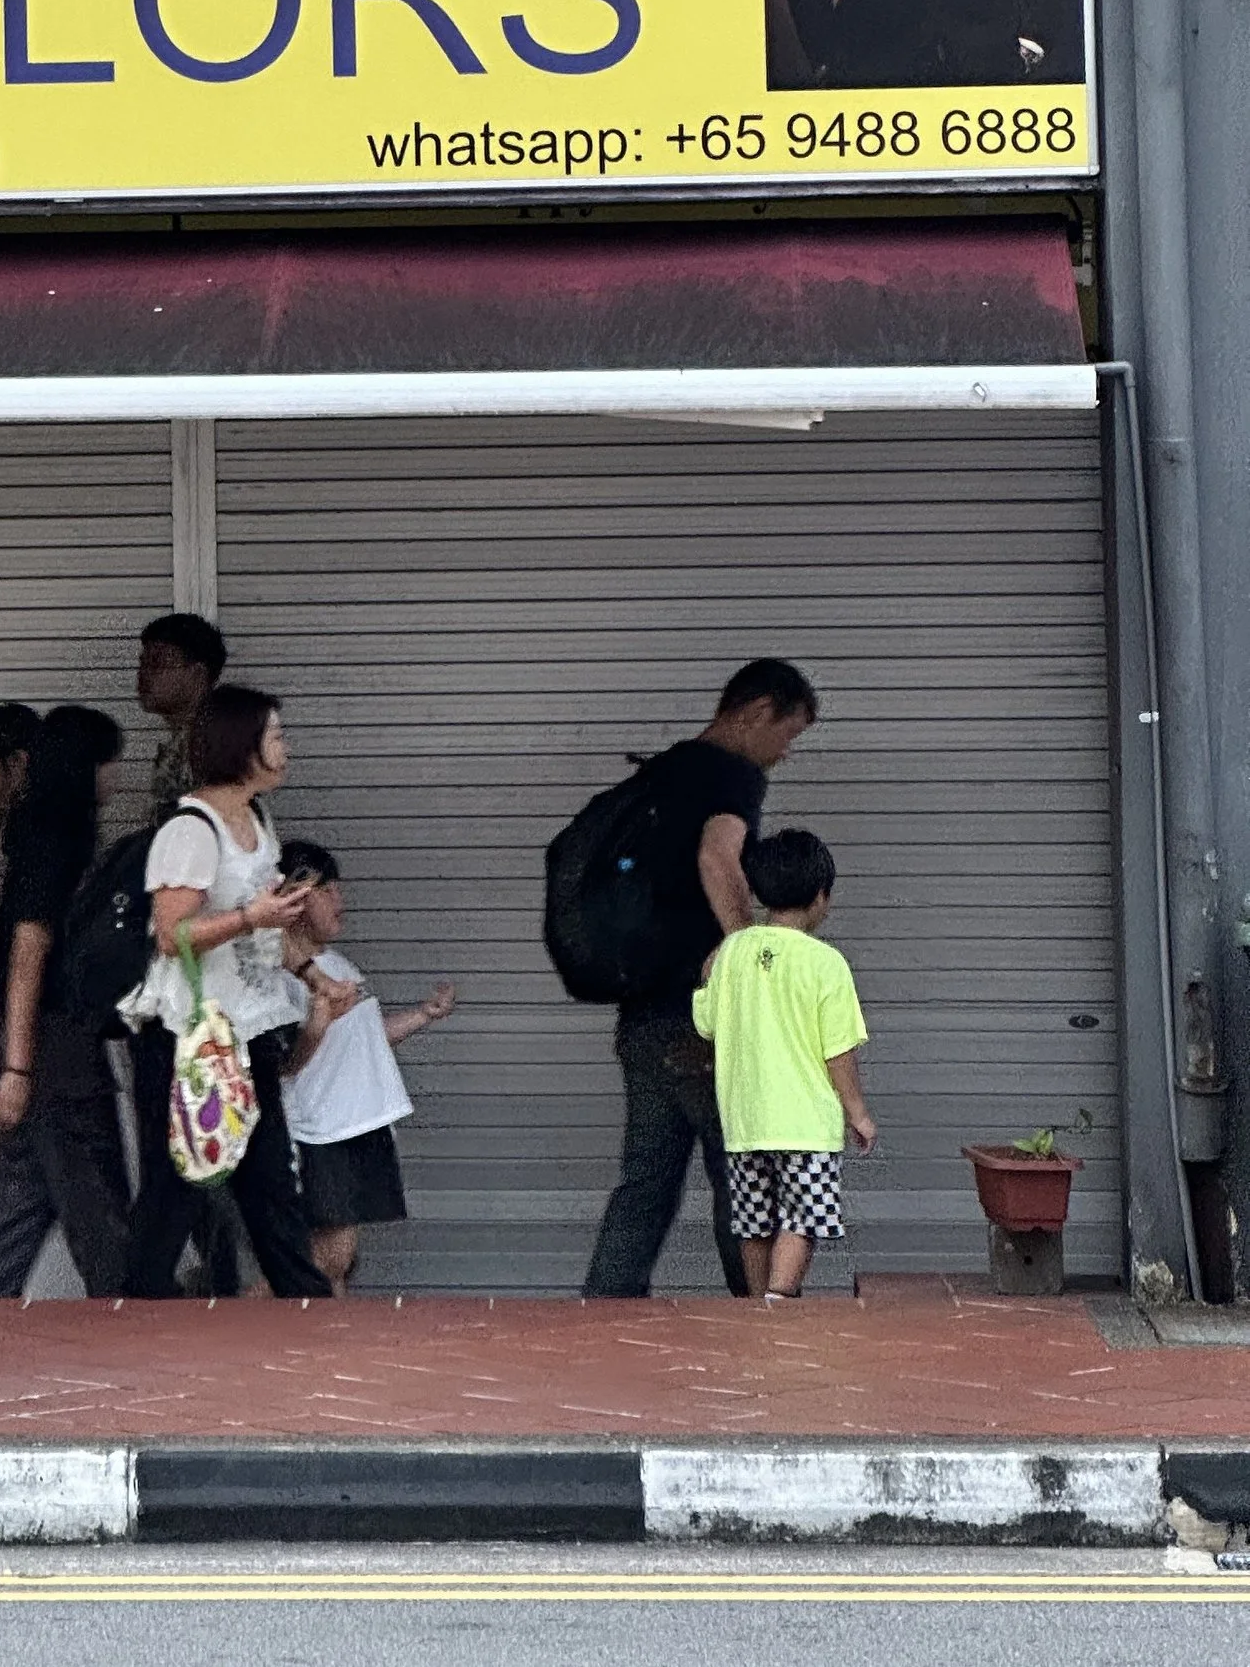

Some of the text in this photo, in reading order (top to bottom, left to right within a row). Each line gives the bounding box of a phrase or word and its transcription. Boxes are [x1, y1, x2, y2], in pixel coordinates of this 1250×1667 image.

[367, 107, 1076, 176] whatsapp: +65 9488 6888
